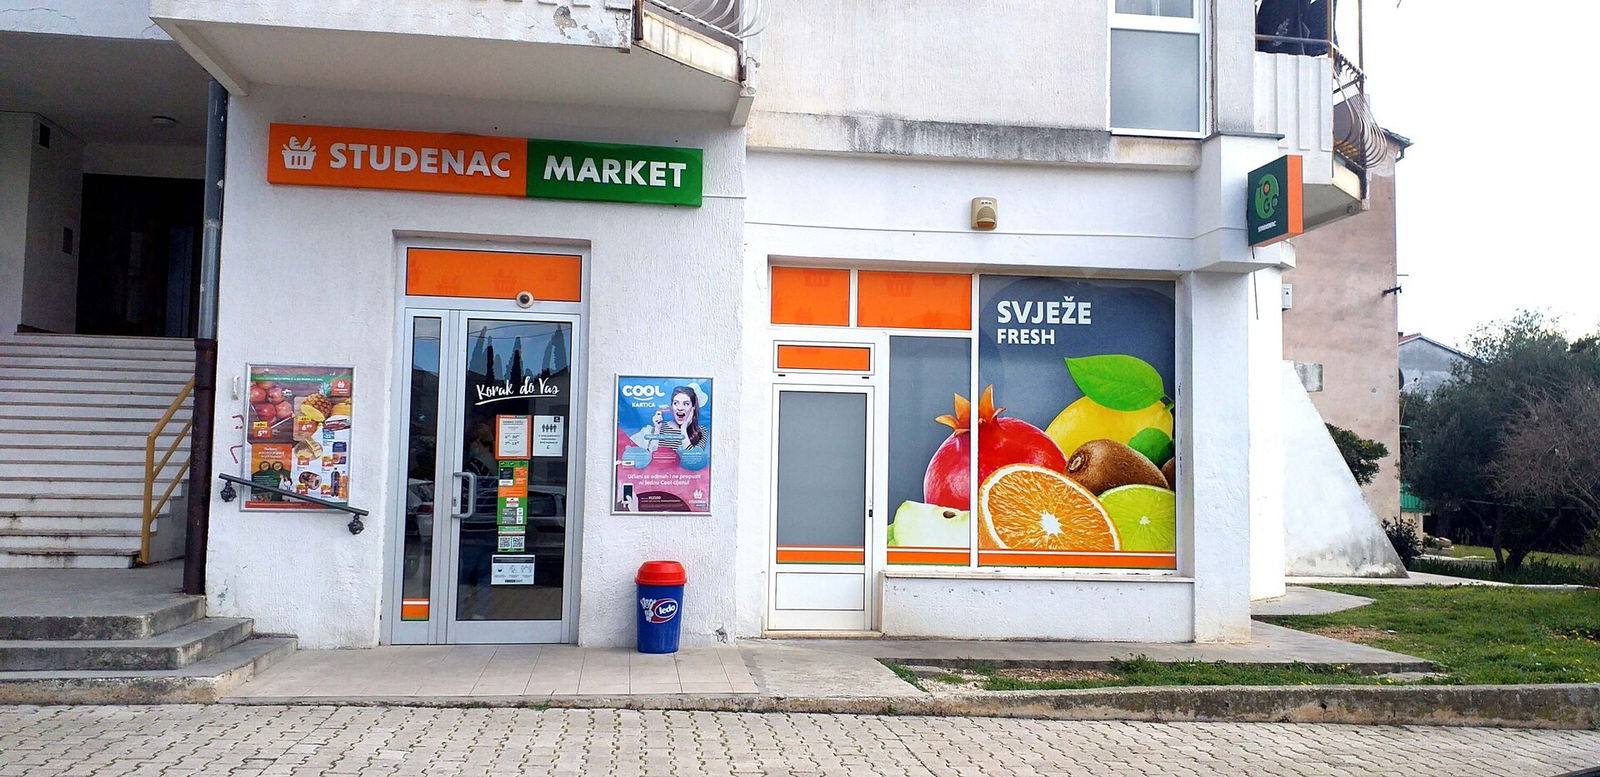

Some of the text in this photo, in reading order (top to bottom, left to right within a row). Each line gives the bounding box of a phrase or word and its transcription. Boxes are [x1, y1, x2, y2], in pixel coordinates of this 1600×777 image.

[330, 143, 687, 188] STUDENAC MARKET
[997, 296, 1092, 325] SVJEŽE
[997, 328, 1055, 345] FRESH
[476, 376, 561, 401] Korak do Vas
[622, 384, 666, 397] COOL
